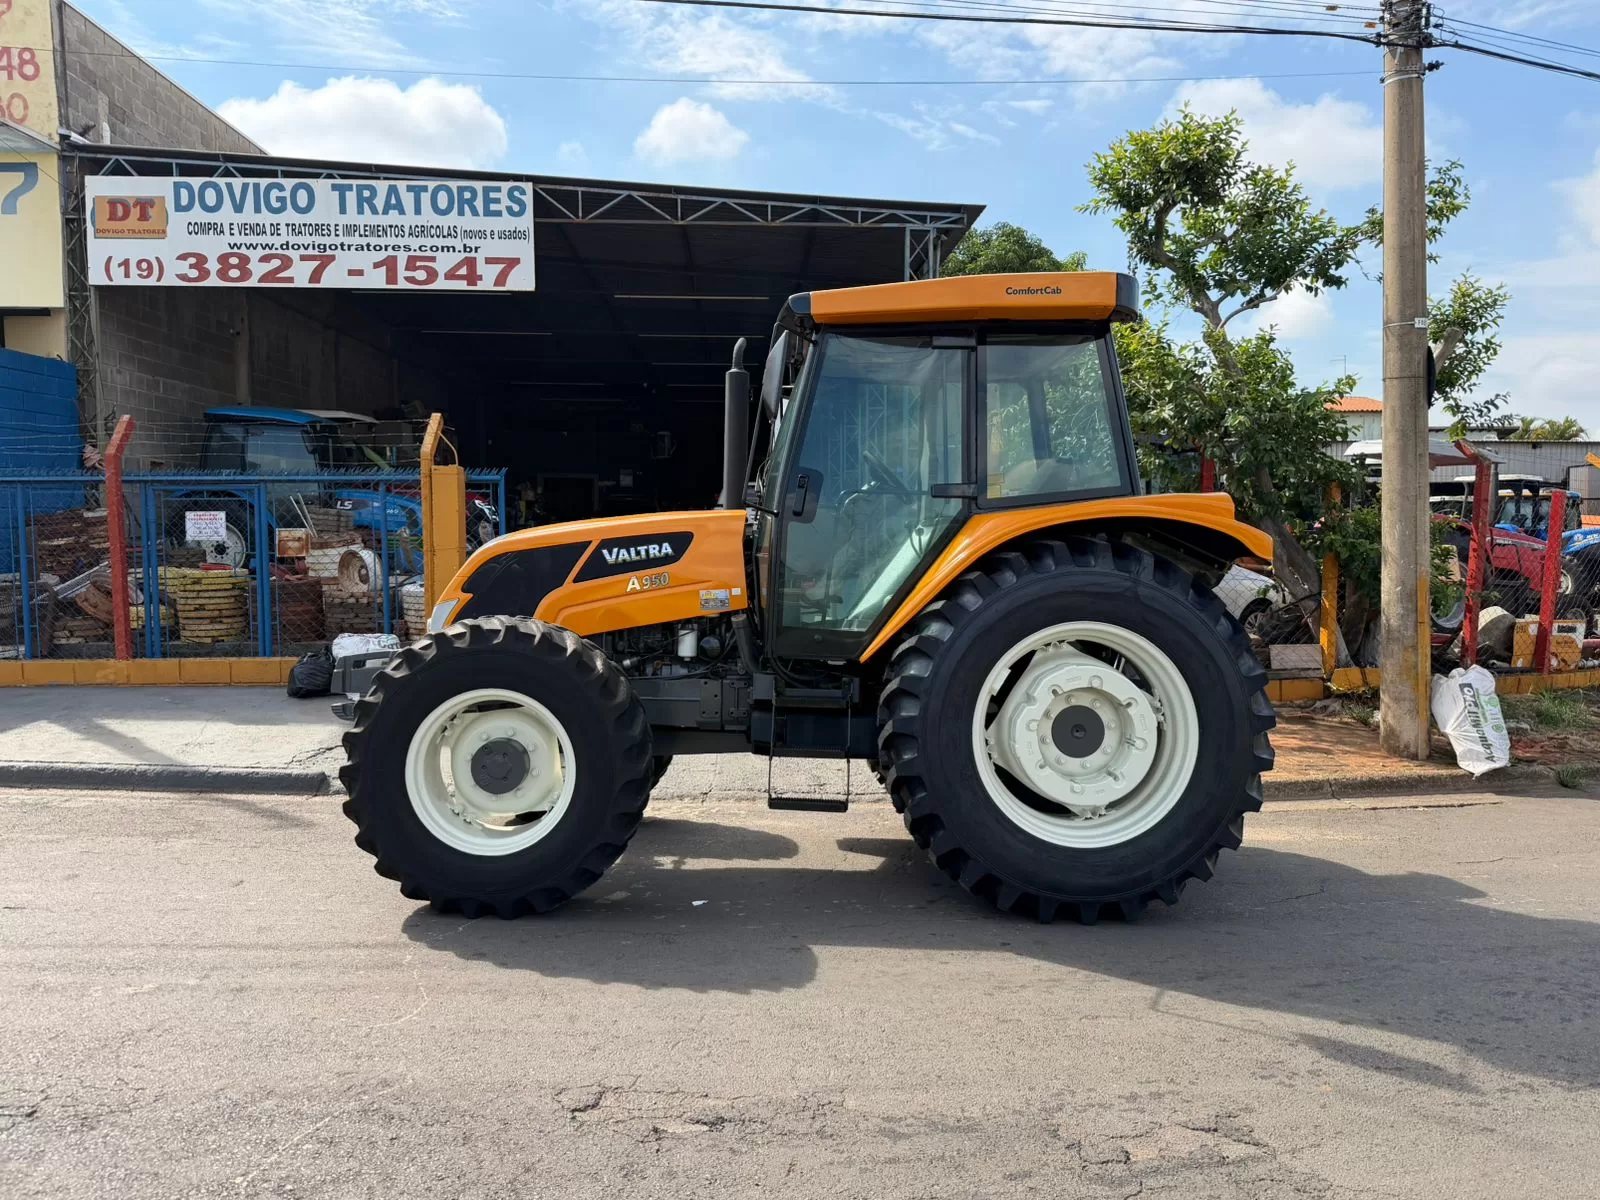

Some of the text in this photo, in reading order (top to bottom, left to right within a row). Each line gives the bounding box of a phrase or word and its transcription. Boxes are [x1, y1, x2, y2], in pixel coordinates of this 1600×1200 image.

[106, 198, 155, 222] DT
[173, 180, 528, 218] DOVIGO TRATORES
[187, 220, 530, 243] COMPRA E VENDA DE TRATORES E IMPLEMENTOS AGRÍCOLAS (novos e usados)
[228, 240, 481, 254] www.dovigotratores.com.br
[104, 255, 165, 282] (19)
[1005, 286, 1062, 295] ComfortCab
[602, 542, 674, 565] VALTRA
